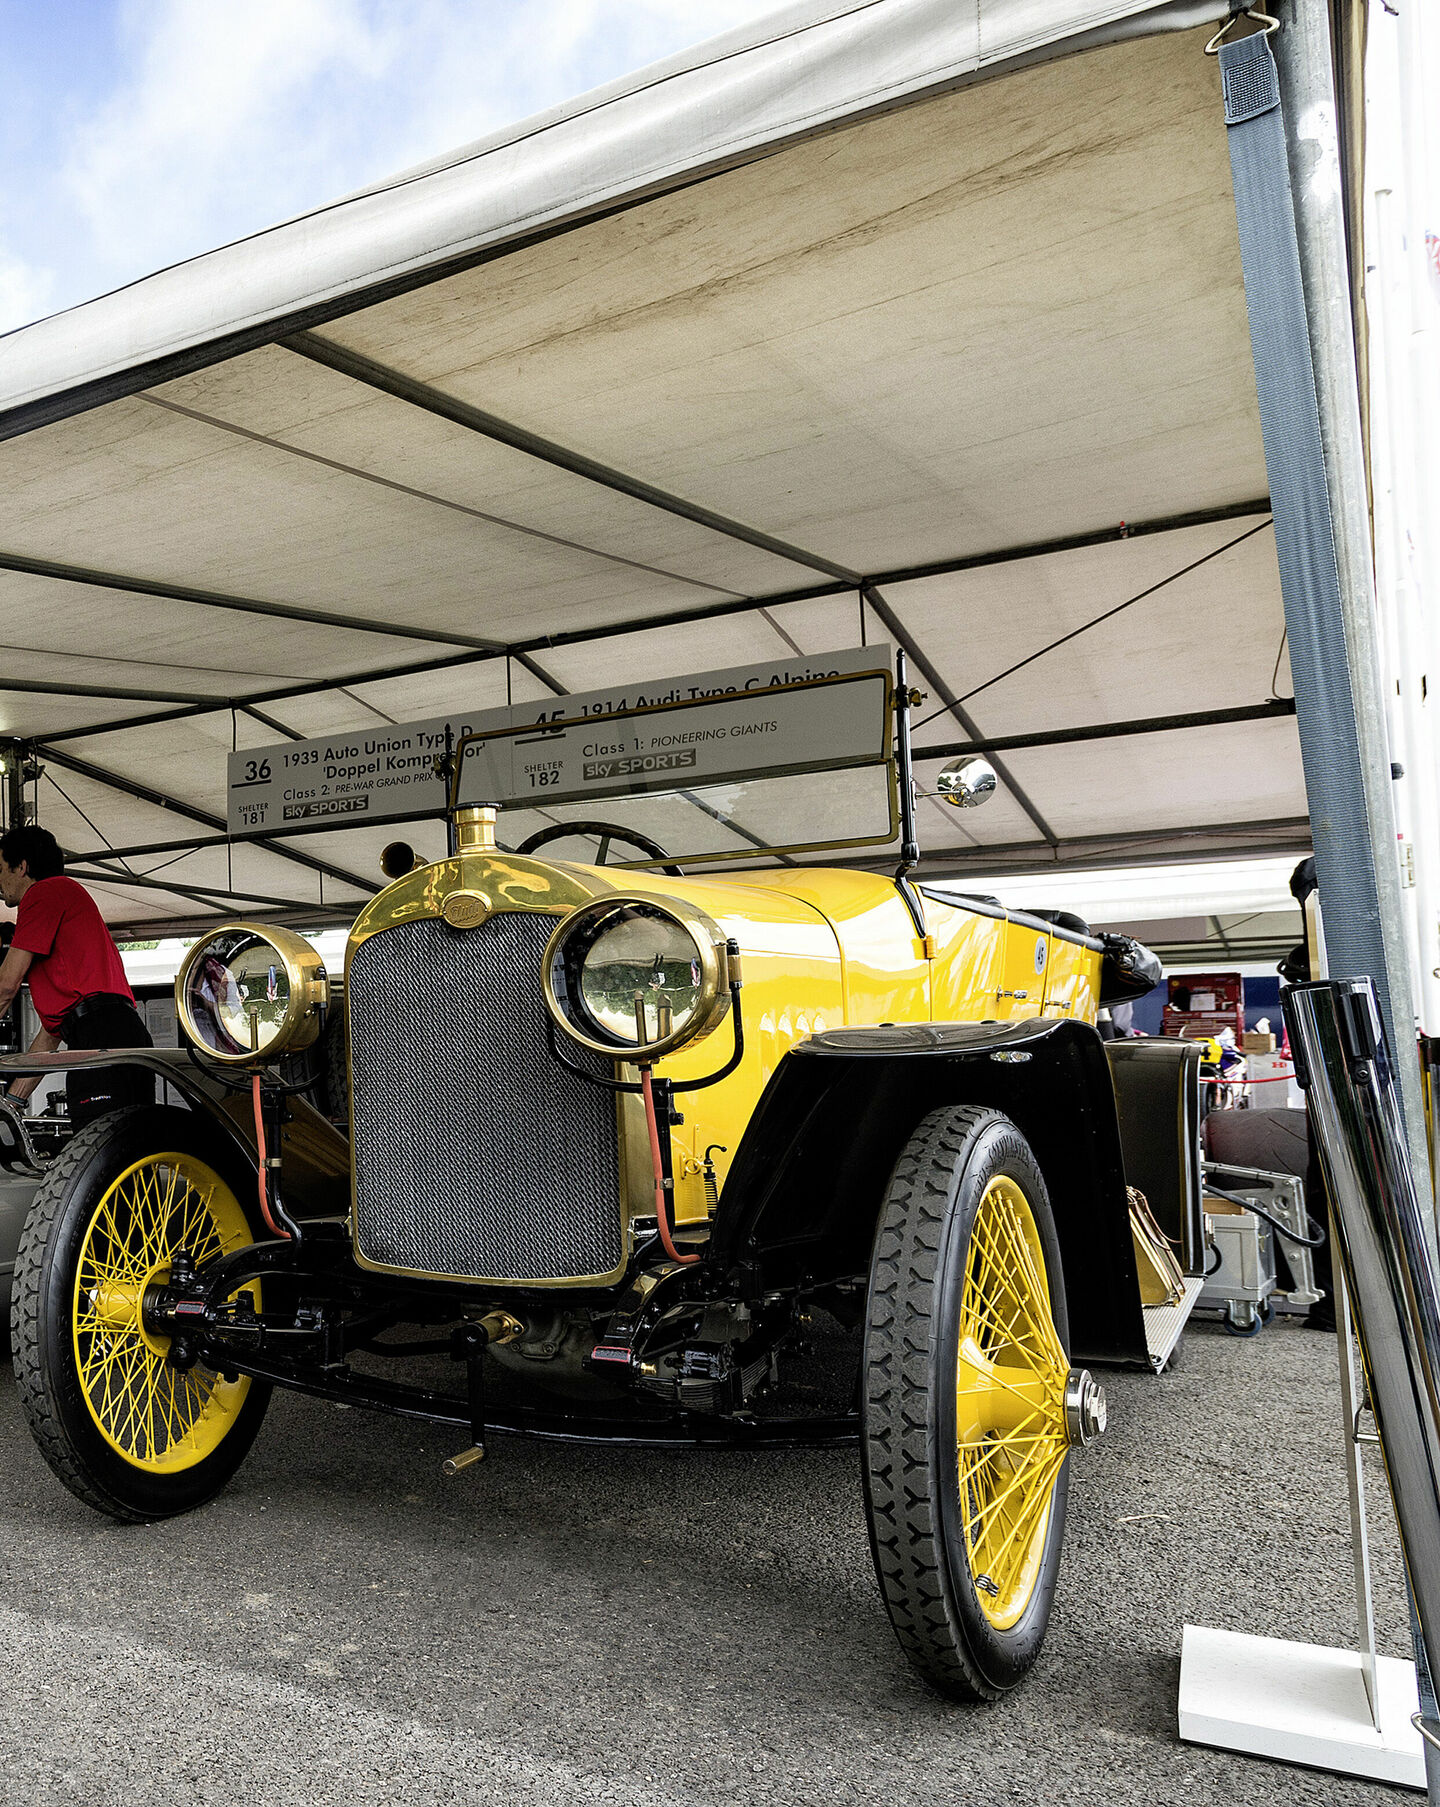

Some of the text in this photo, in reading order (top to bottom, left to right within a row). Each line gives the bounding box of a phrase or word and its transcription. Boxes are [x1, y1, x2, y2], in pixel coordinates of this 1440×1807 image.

[324, 744, 360, 762] Auto
[364, 737, 411, 756] Union
[582, 720, 778, 758] Class 1: PIONEERING GIANTS
[244, 758, 272, 782] 36
[322, 757, 381, 781] 'Doppel
[523, 760, 565, 774] SHELTER
[586, 752, 693, 779] sky SPORTS
[283, 771, 434, 801] Class 2: PRE-WAR GRAND PRIX
[528, 770, 561, 788] 182
[238, 802, 269, 814] SHELTER
[242, 811, 266, 825] 181
[285, 797, 367, 819] sky SPORTS
